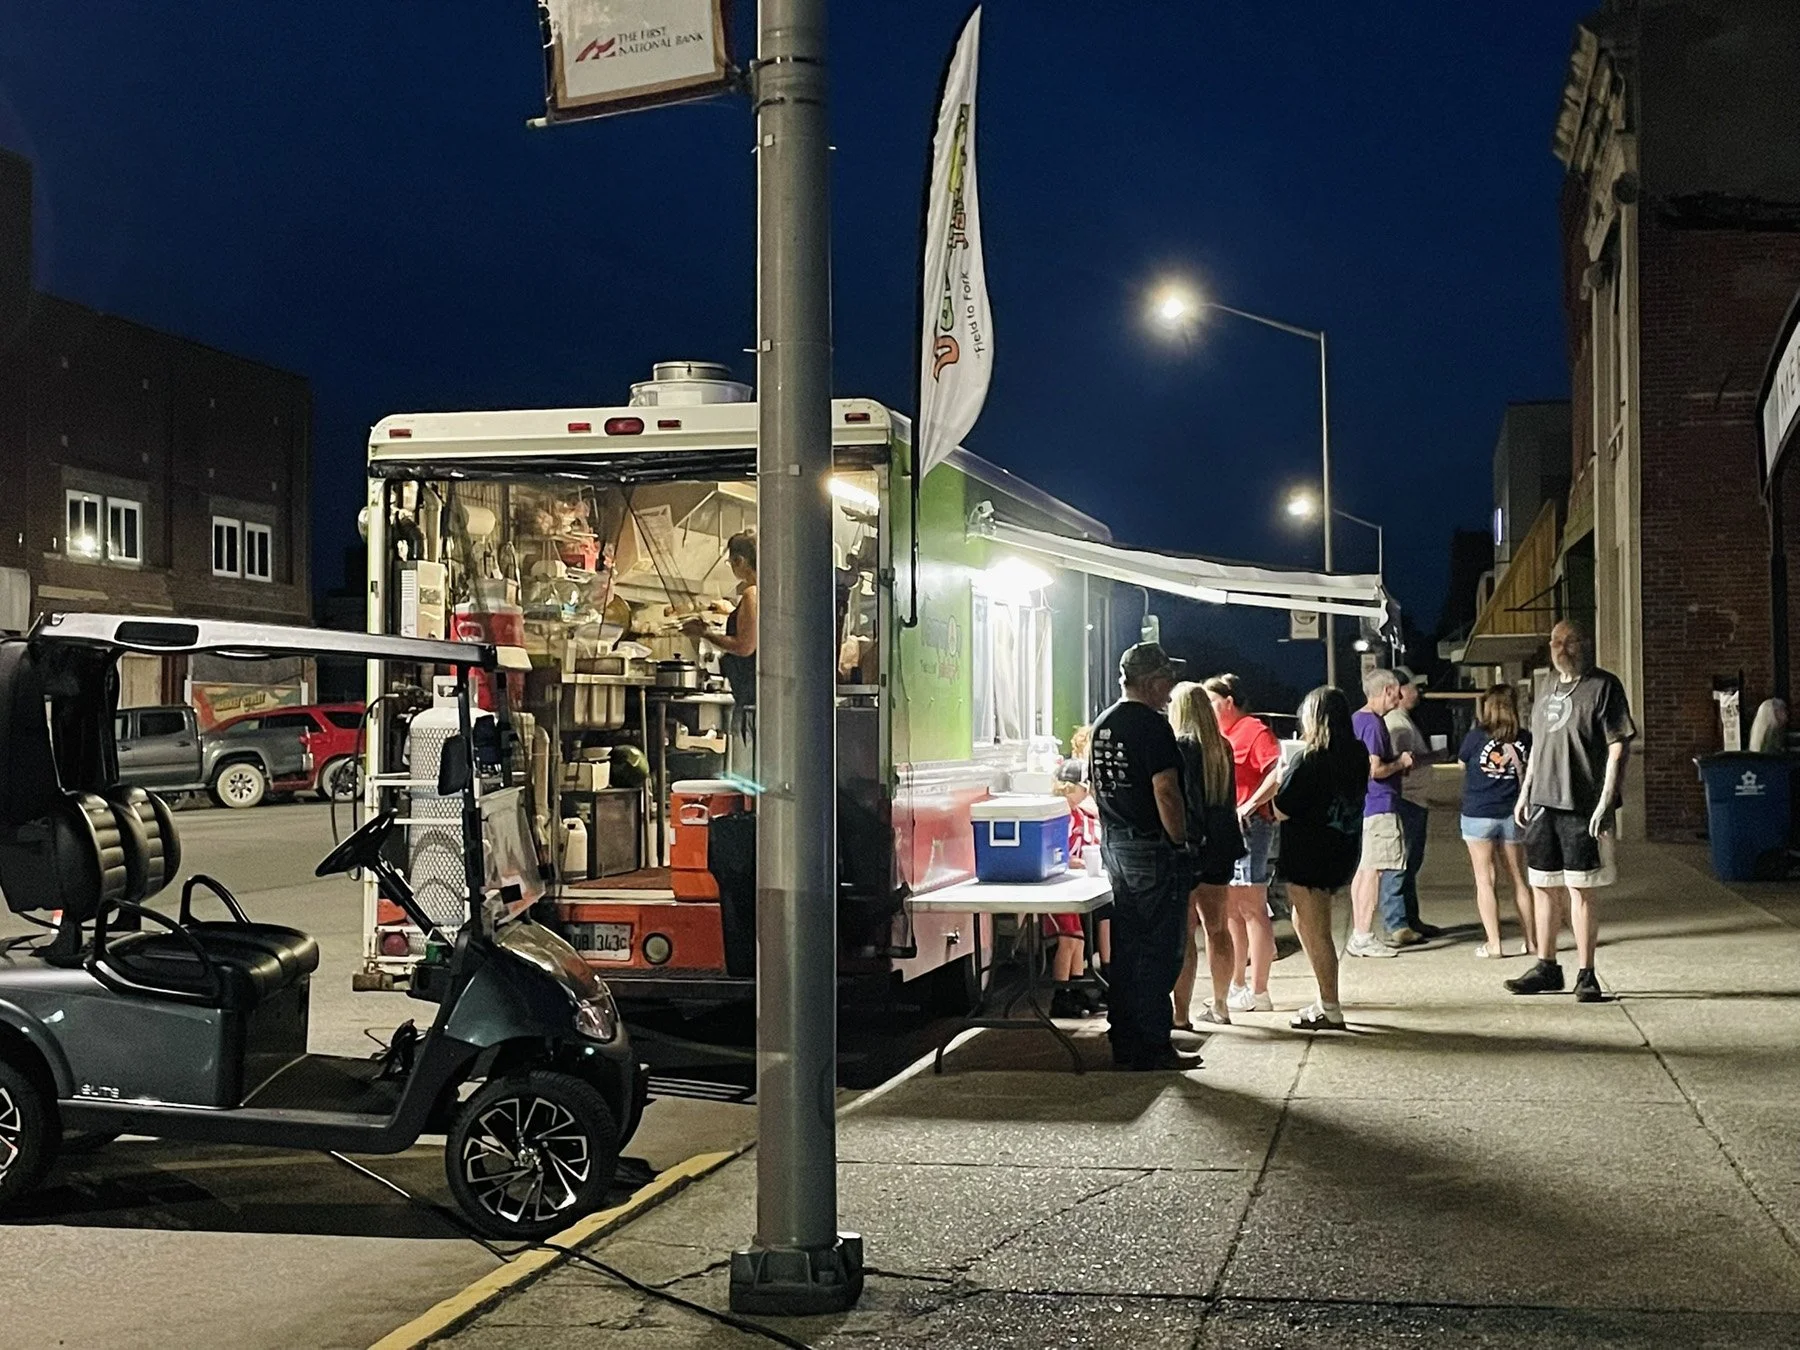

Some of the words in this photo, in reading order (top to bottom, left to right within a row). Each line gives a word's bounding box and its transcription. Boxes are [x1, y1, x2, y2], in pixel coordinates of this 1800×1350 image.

[617, 31, 637, 44] THE
[641, 26, 666, 40] FIRST
[618, 37, 671, 56] NATIONAL
[675, 32, 704, 46] BANK
